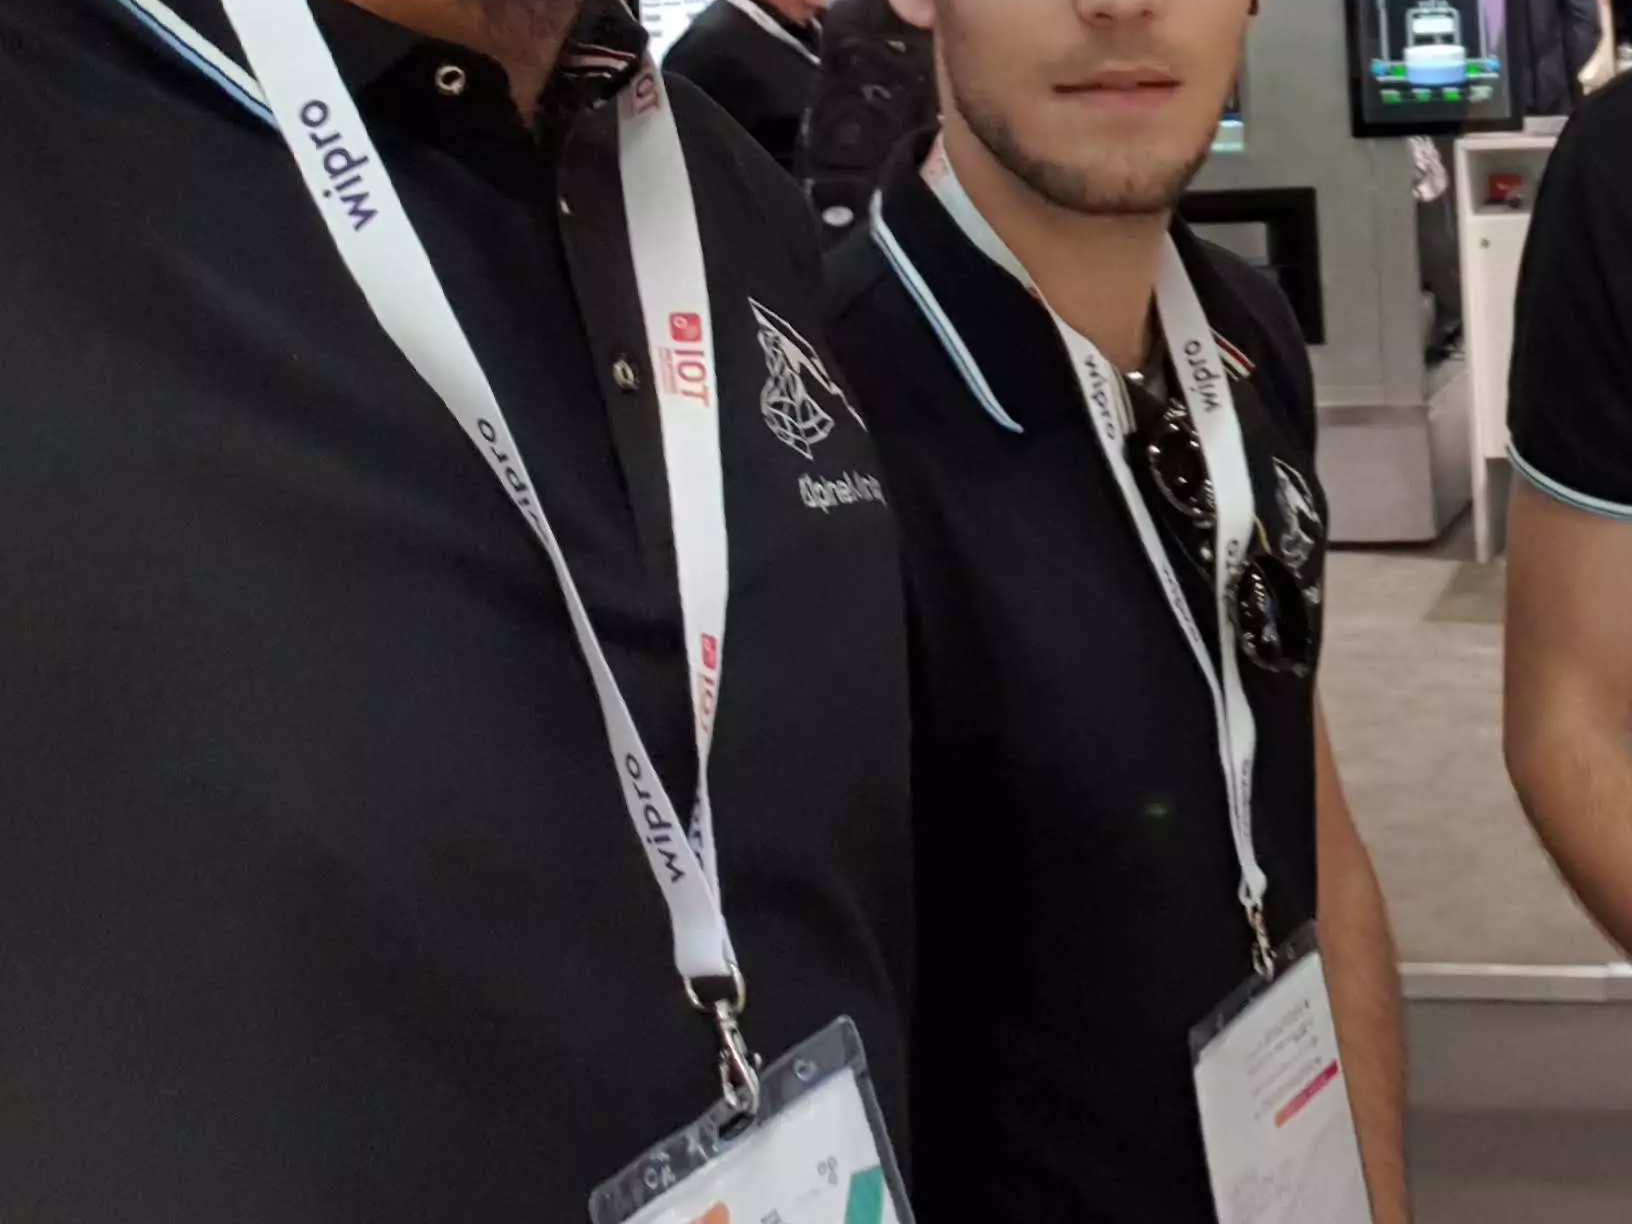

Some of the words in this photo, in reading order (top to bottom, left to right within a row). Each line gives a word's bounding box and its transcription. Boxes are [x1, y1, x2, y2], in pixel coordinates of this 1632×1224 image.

[300, 98, 379, 232] wipro
[674, 349, 711, 409] IOT
[1184, 339, 1222, 413] wipro
[625, 752, 686, 883] wipro
